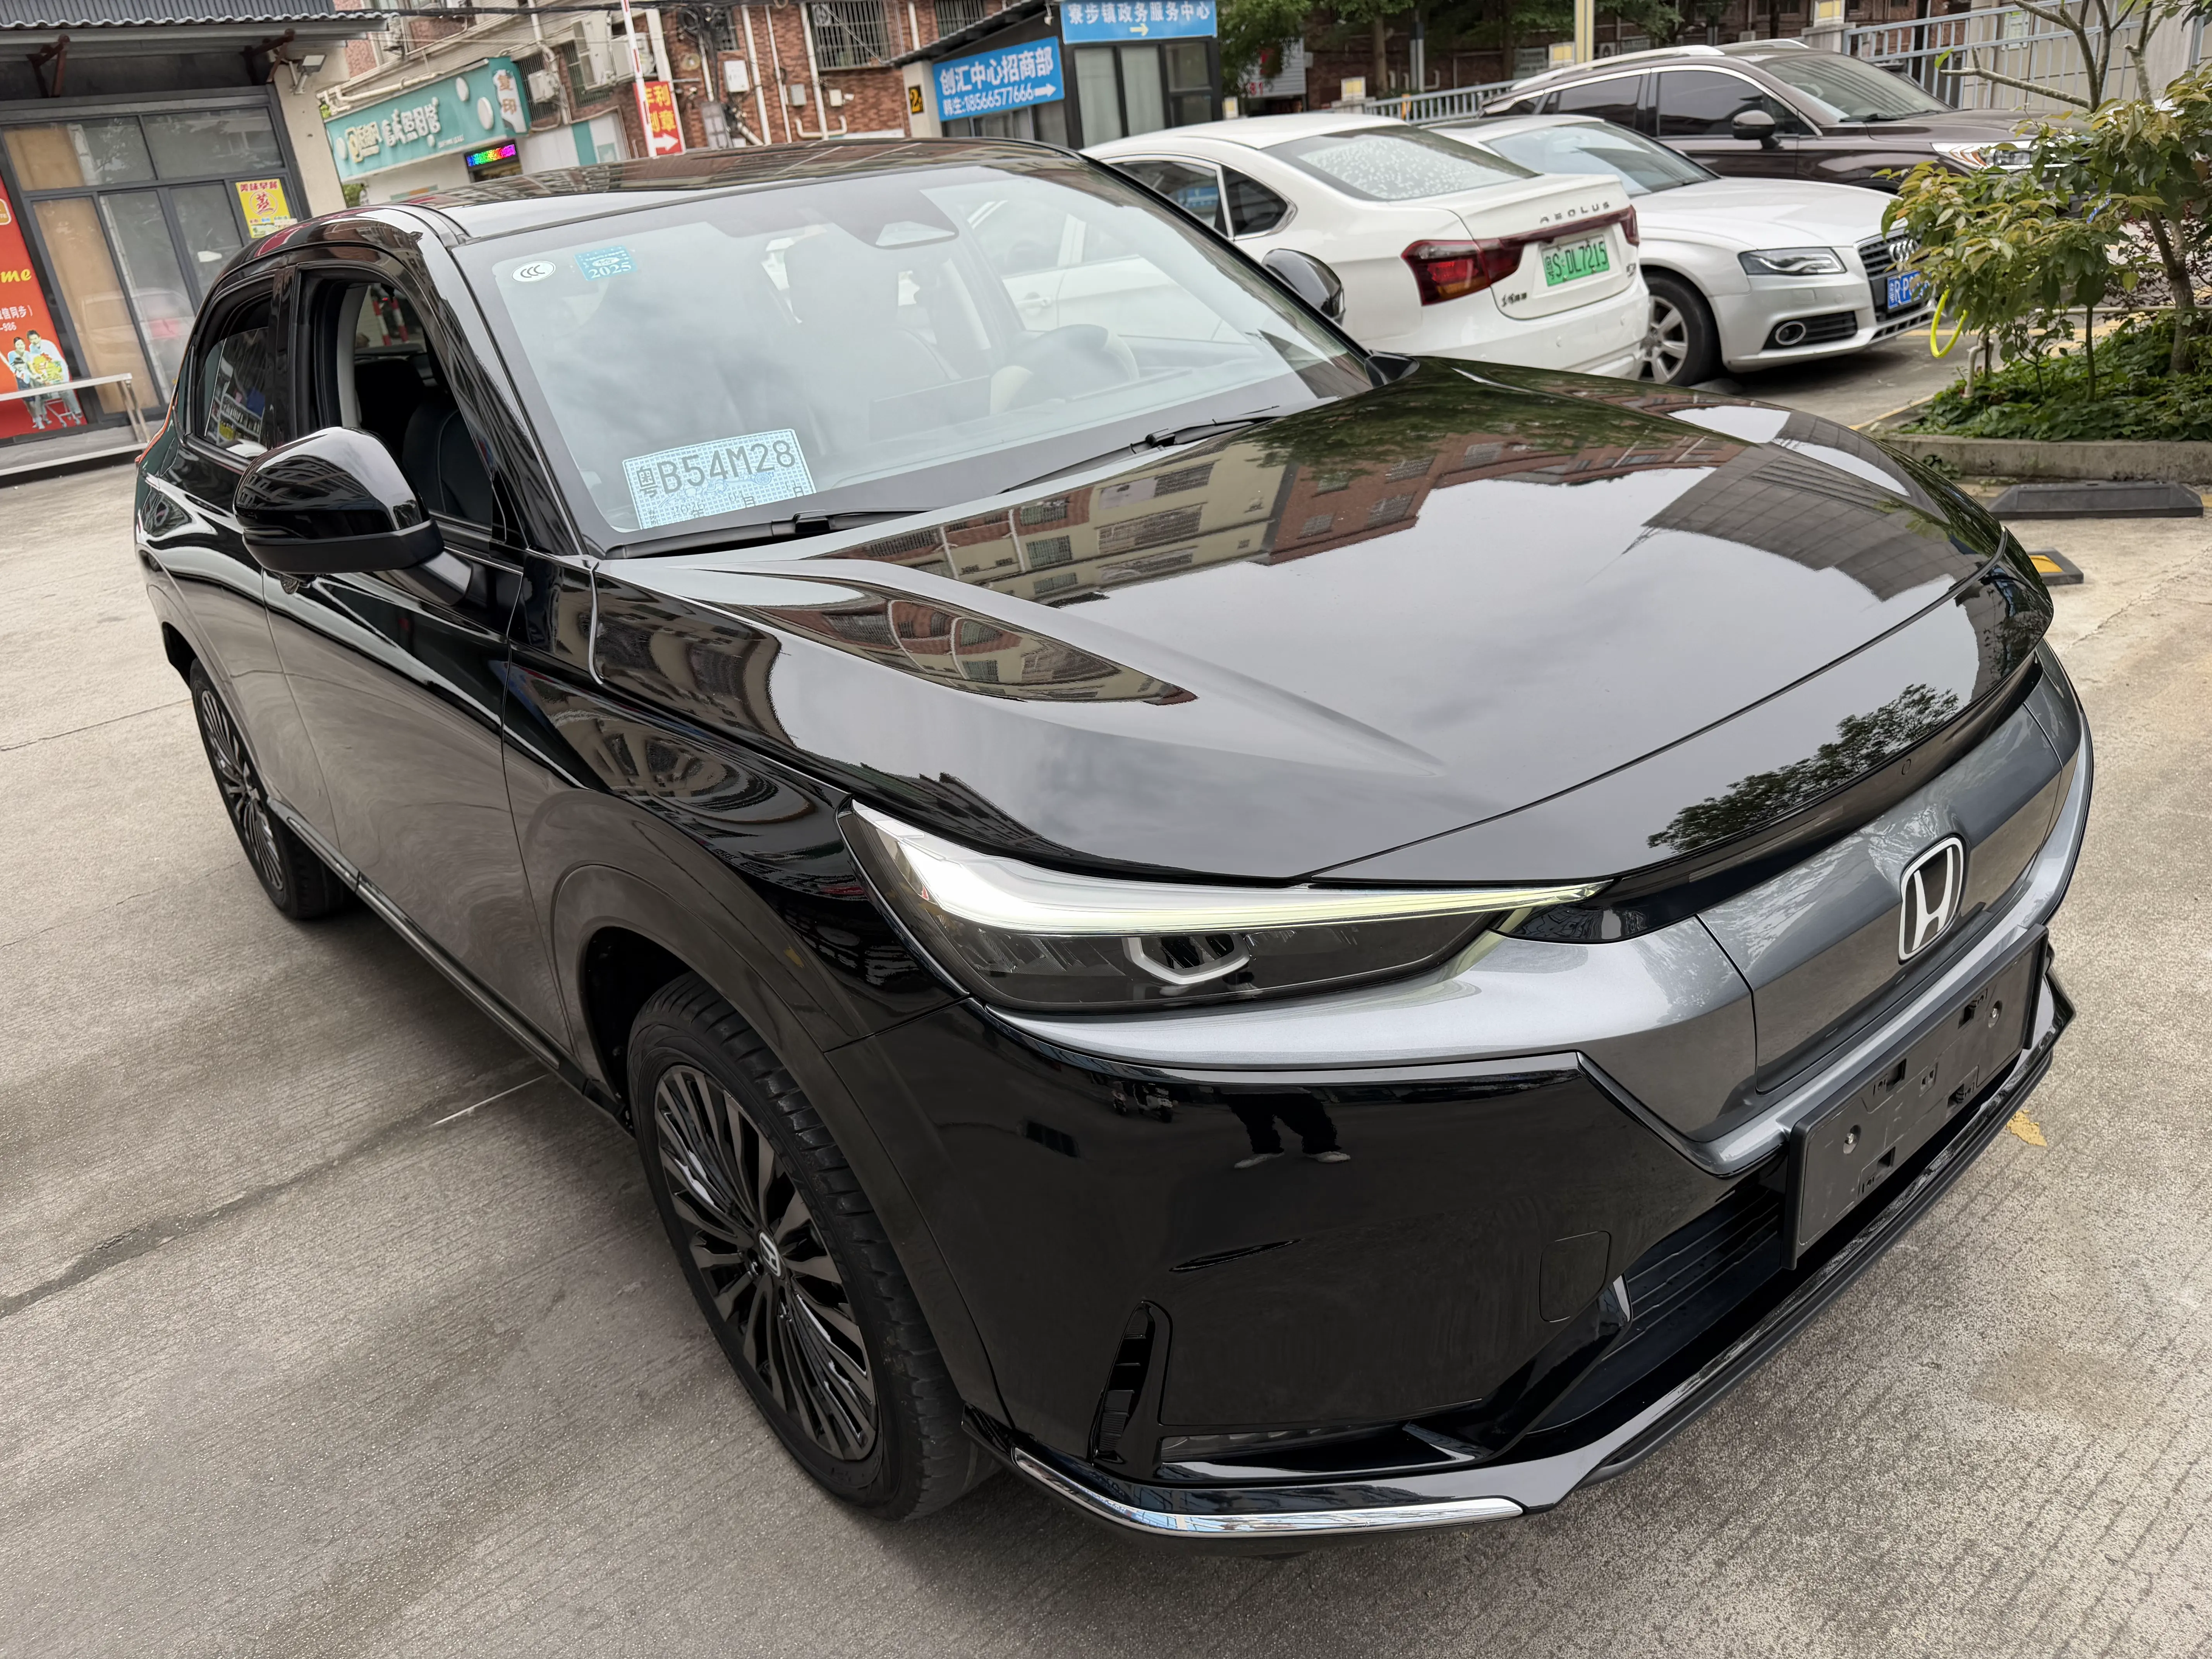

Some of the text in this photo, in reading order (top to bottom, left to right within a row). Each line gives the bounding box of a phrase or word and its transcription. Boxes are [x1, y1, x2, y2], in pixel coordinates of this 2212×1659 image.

[1068, 1, 1211, 24] 寮步镇政务服务中心
[939, 46, 1054, 96] 创汇中心招商部
[1540, 201, 1610, 224] AEOLUS
[588, 261, 632, 279] 2025
[636, 440, 795, 498] 粤B54M28
